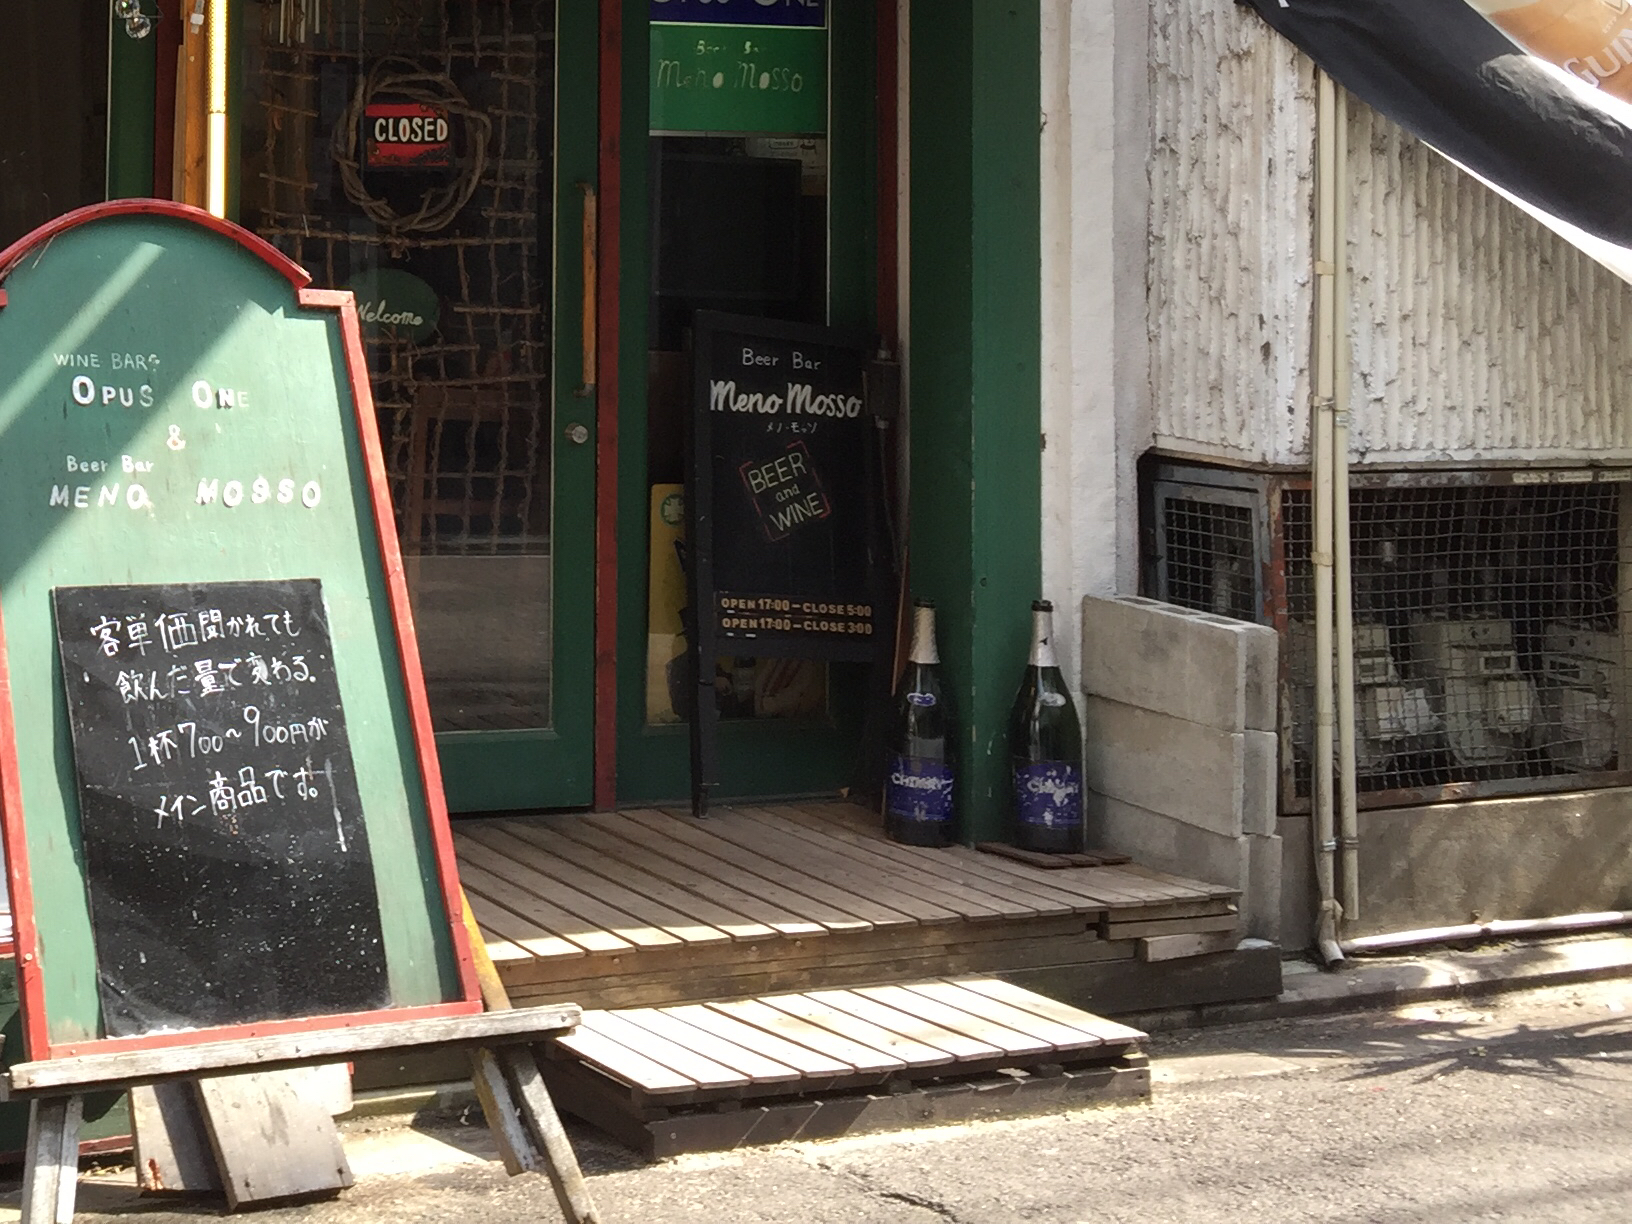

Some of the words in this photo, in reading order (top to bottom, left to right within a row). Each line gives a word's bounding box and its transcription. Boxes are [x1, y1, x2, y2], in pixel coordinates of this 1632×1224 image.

[374, 117, 448, 143] CLOSED
[54, 352, 100, 368] WINE
[742, 348, 779, 367] Beer
[792, 352, 821, 370] Bar
[710, 379, 783, 414] Meno
[786, 382, 862, 418] Mosso
[166, 424, 186, 450] &
[66, 455, 108, 473] Beer
[122, 455, 155, 473] Bar
[747, 452, 808, 495] BEER
[49, 483, 148, 509] MENO
[195, 477, 321, 508] MOSSO
[775, 483, 801, 504] and
[770, 492, 824, 533] WINE
[721, 598, 755, 610] OPEN
[757, 598, 790, 612] 17:00
[802, 602, 845, 616] CLOSE
[721, 618, 758, 630] OPEN
[759, 618, 791, 631] 17:00
[803, 621, 845, 633] CLOSE
